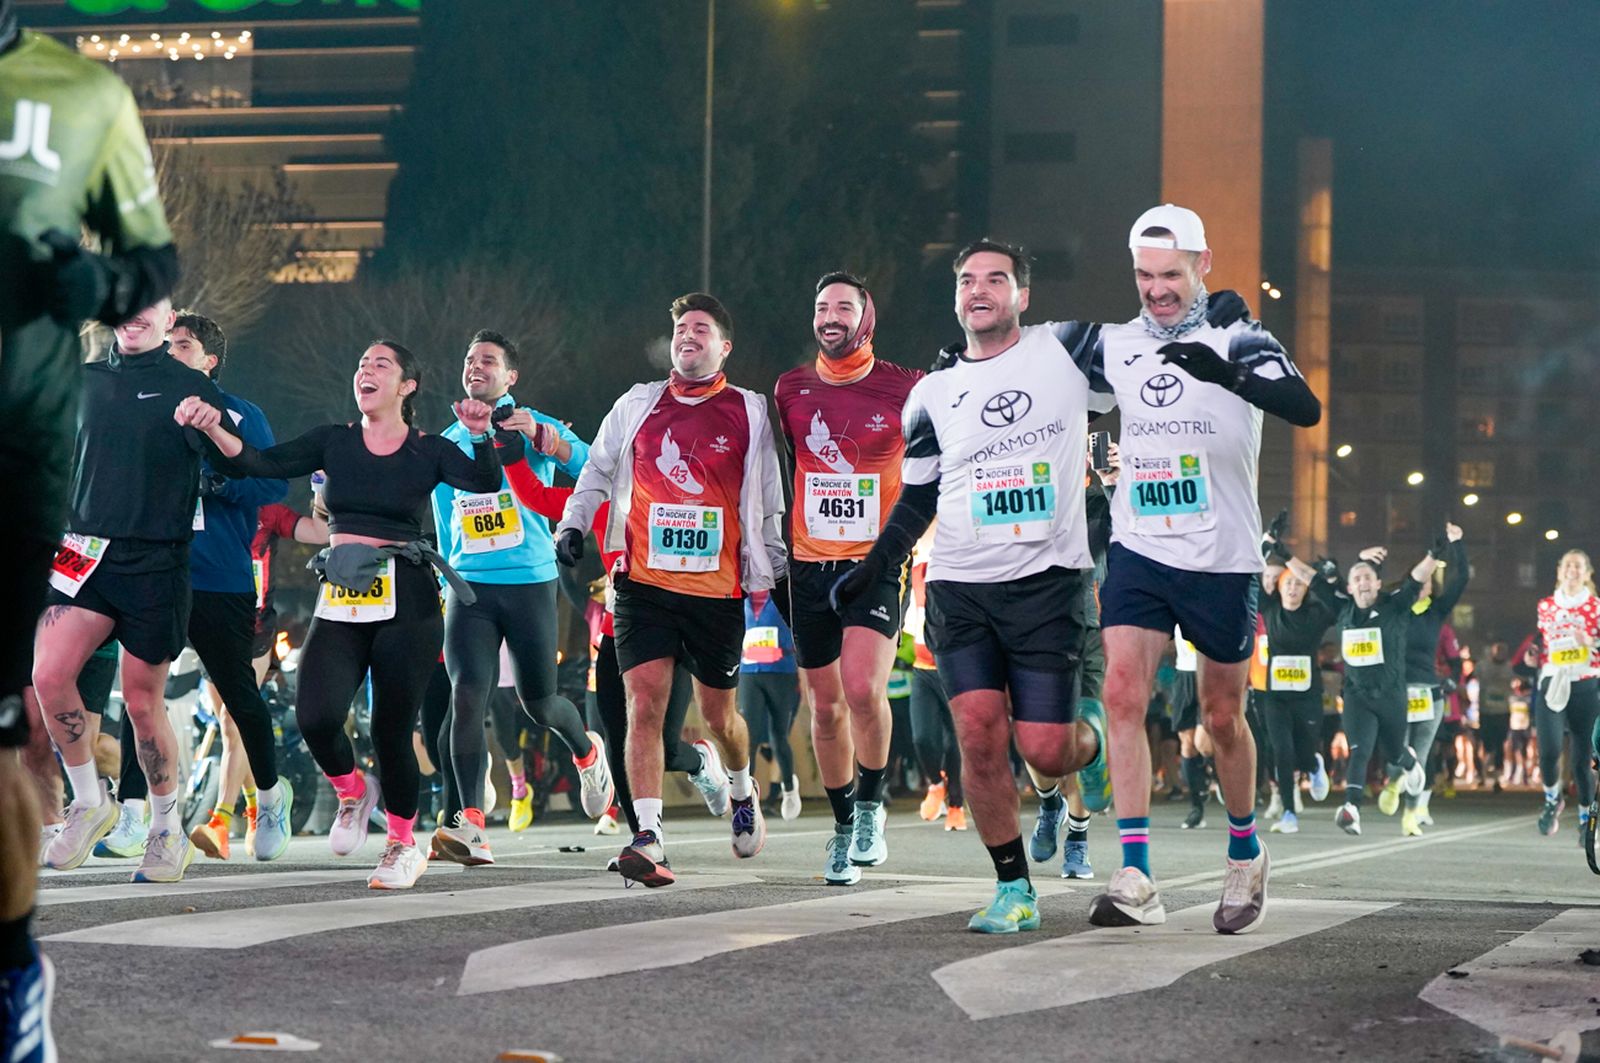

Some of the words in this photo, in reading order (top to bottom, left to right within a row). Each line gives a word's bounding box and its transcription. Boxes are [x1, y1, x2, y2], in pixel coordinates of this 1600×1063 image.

[1127, 420, 1216, 436] YOKAMOTRIL
[963, 419, 1066, 463] YOKAMOTRIL
[819, 445, 838, 463] 43
[985, 468, 1011, 479] NOCHE
[1013, 467, 1024, 476] DE
[1162, 460, 1171, 468] DE
[669, 465, 688, 484] 43
[976, 481, 993, 491] SAN
[1136, 479, 1197, 507] 14010
[819, 497, 864, 518] 4631
[982, 486, 1046, 516] 14011
[474, 512, 505, 533] 684
[656, 519, 671, 527] SAN
[665, 511, 687, 519] NOCHE
[687, 512, 697, 520] DE
[662, 528, 708, 550] 8130
